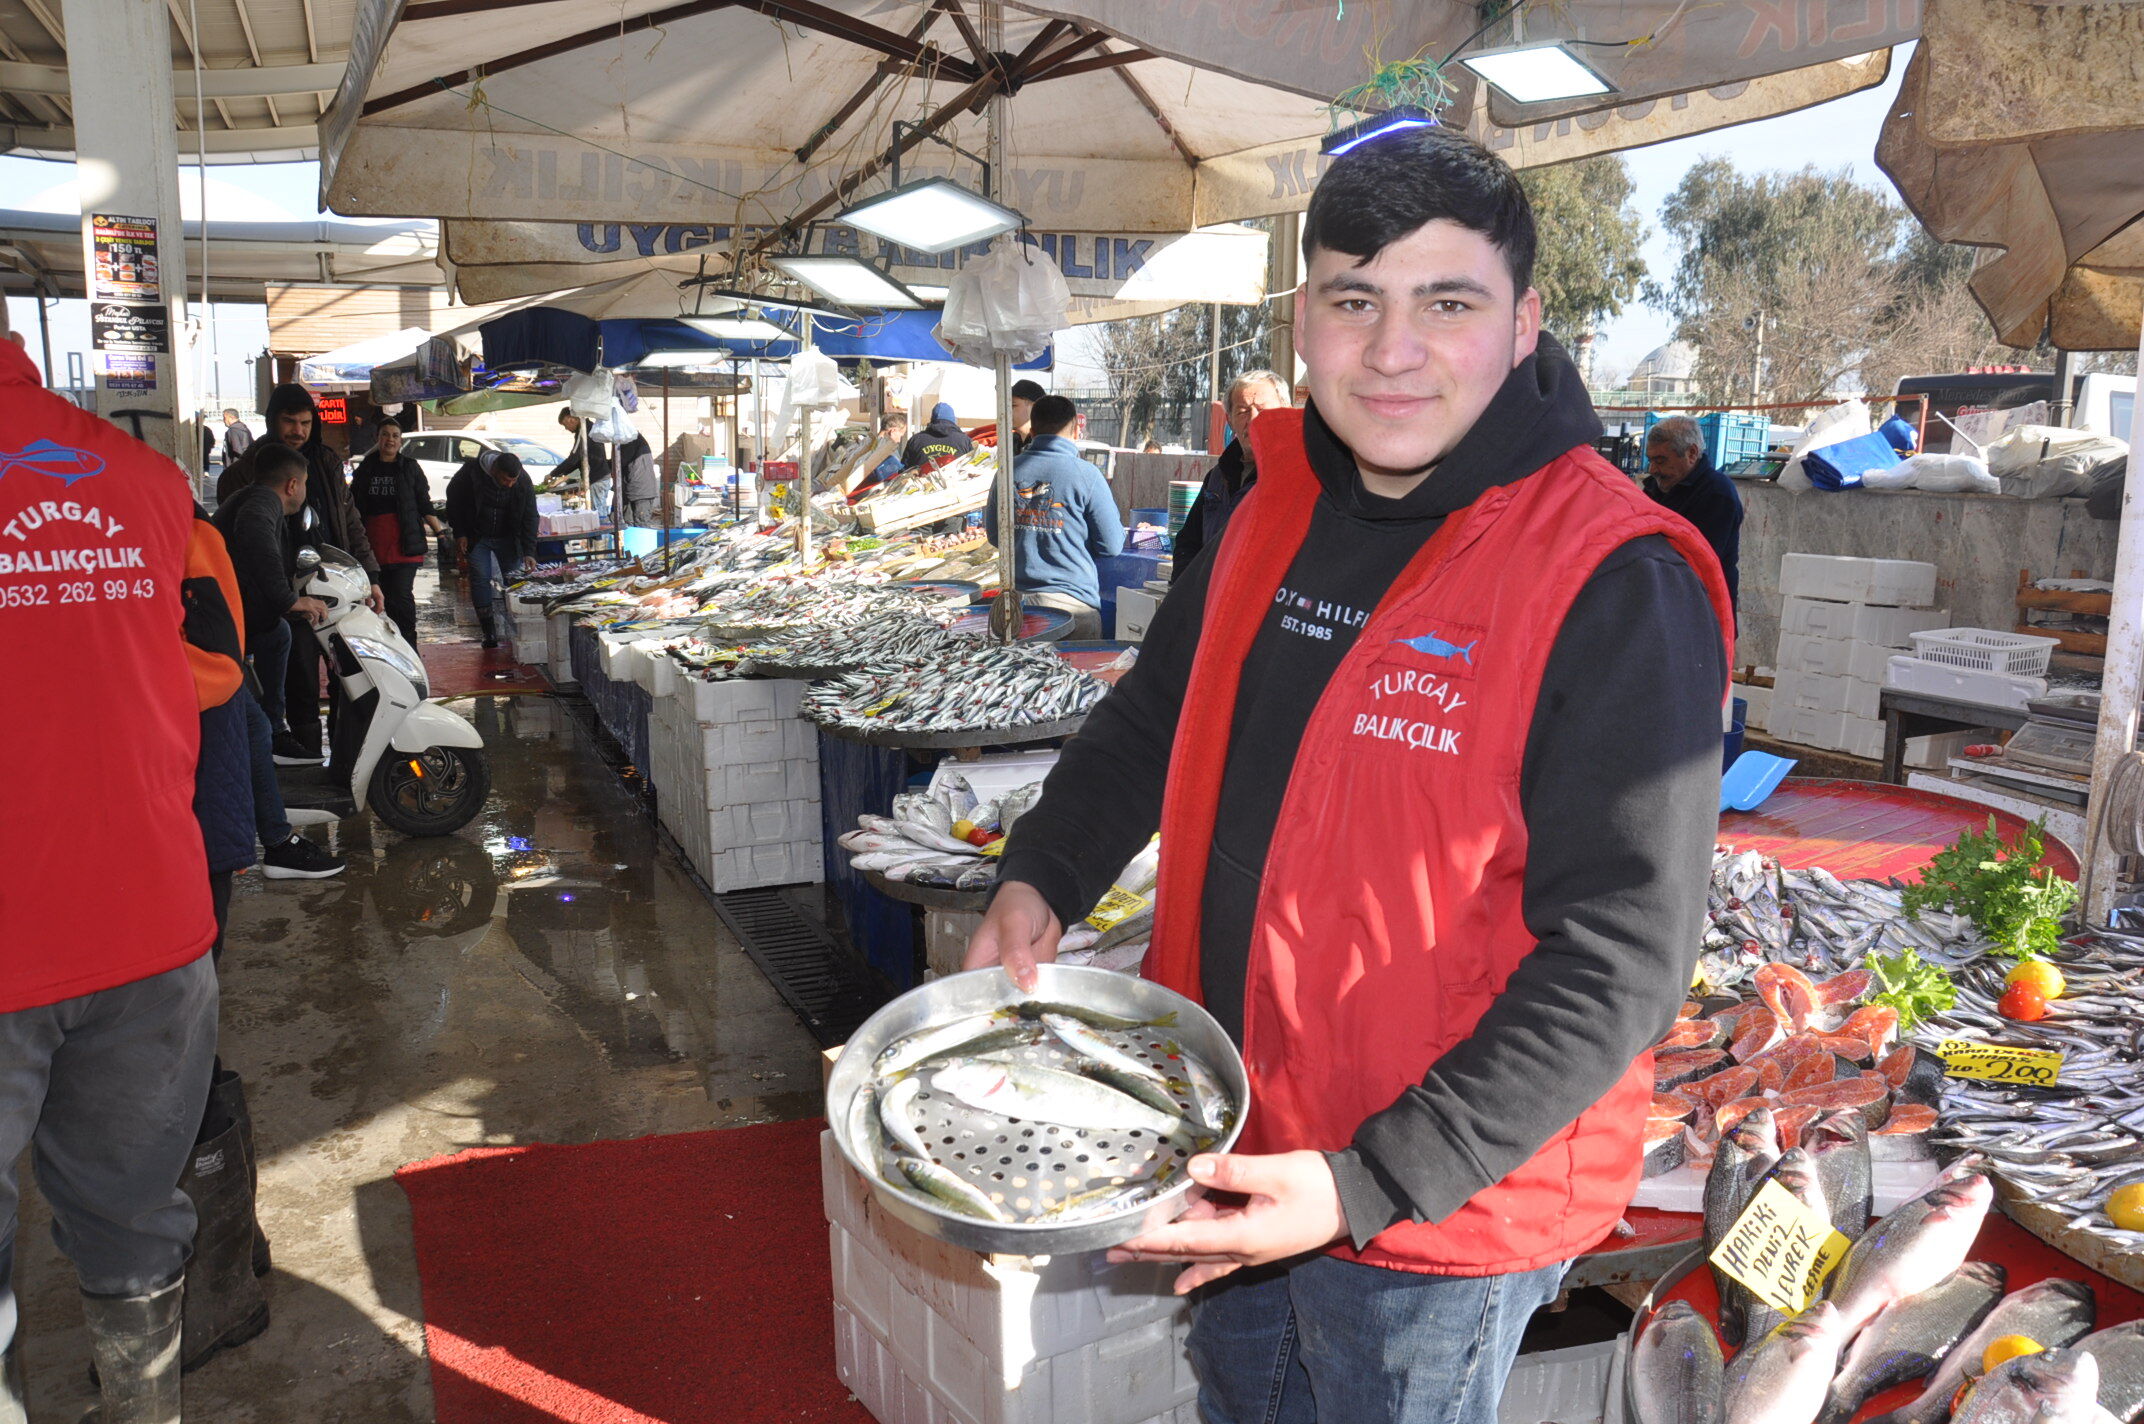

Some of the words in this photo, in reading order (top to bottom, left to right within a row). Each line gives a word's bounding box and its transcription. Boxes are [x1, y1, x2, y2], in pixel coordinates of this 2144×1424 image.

[128, 218, 155, 226] TABLDOT
[823, 225, 1155, 280] BALIKILIK
[922, 444, 958, 457] UYGUN
[3, 501, 125, 541] TURGAY
[0, 547, 145, 575] BALIKÇILIK
[58, 581, 96, 604] 262
[103, 579, 128, 601] 99
[132, 578, 155, 599] 43
[1281, 614, 1333, 641] EST.1985
[1369, 670, 1467, 714] TURGAY
[1353, 713, 1462, 755] BALIKÇILIK
[1985, 1060, 2054, 1080] 200
[1770, 1224, 1821, 1314] LEVREK
